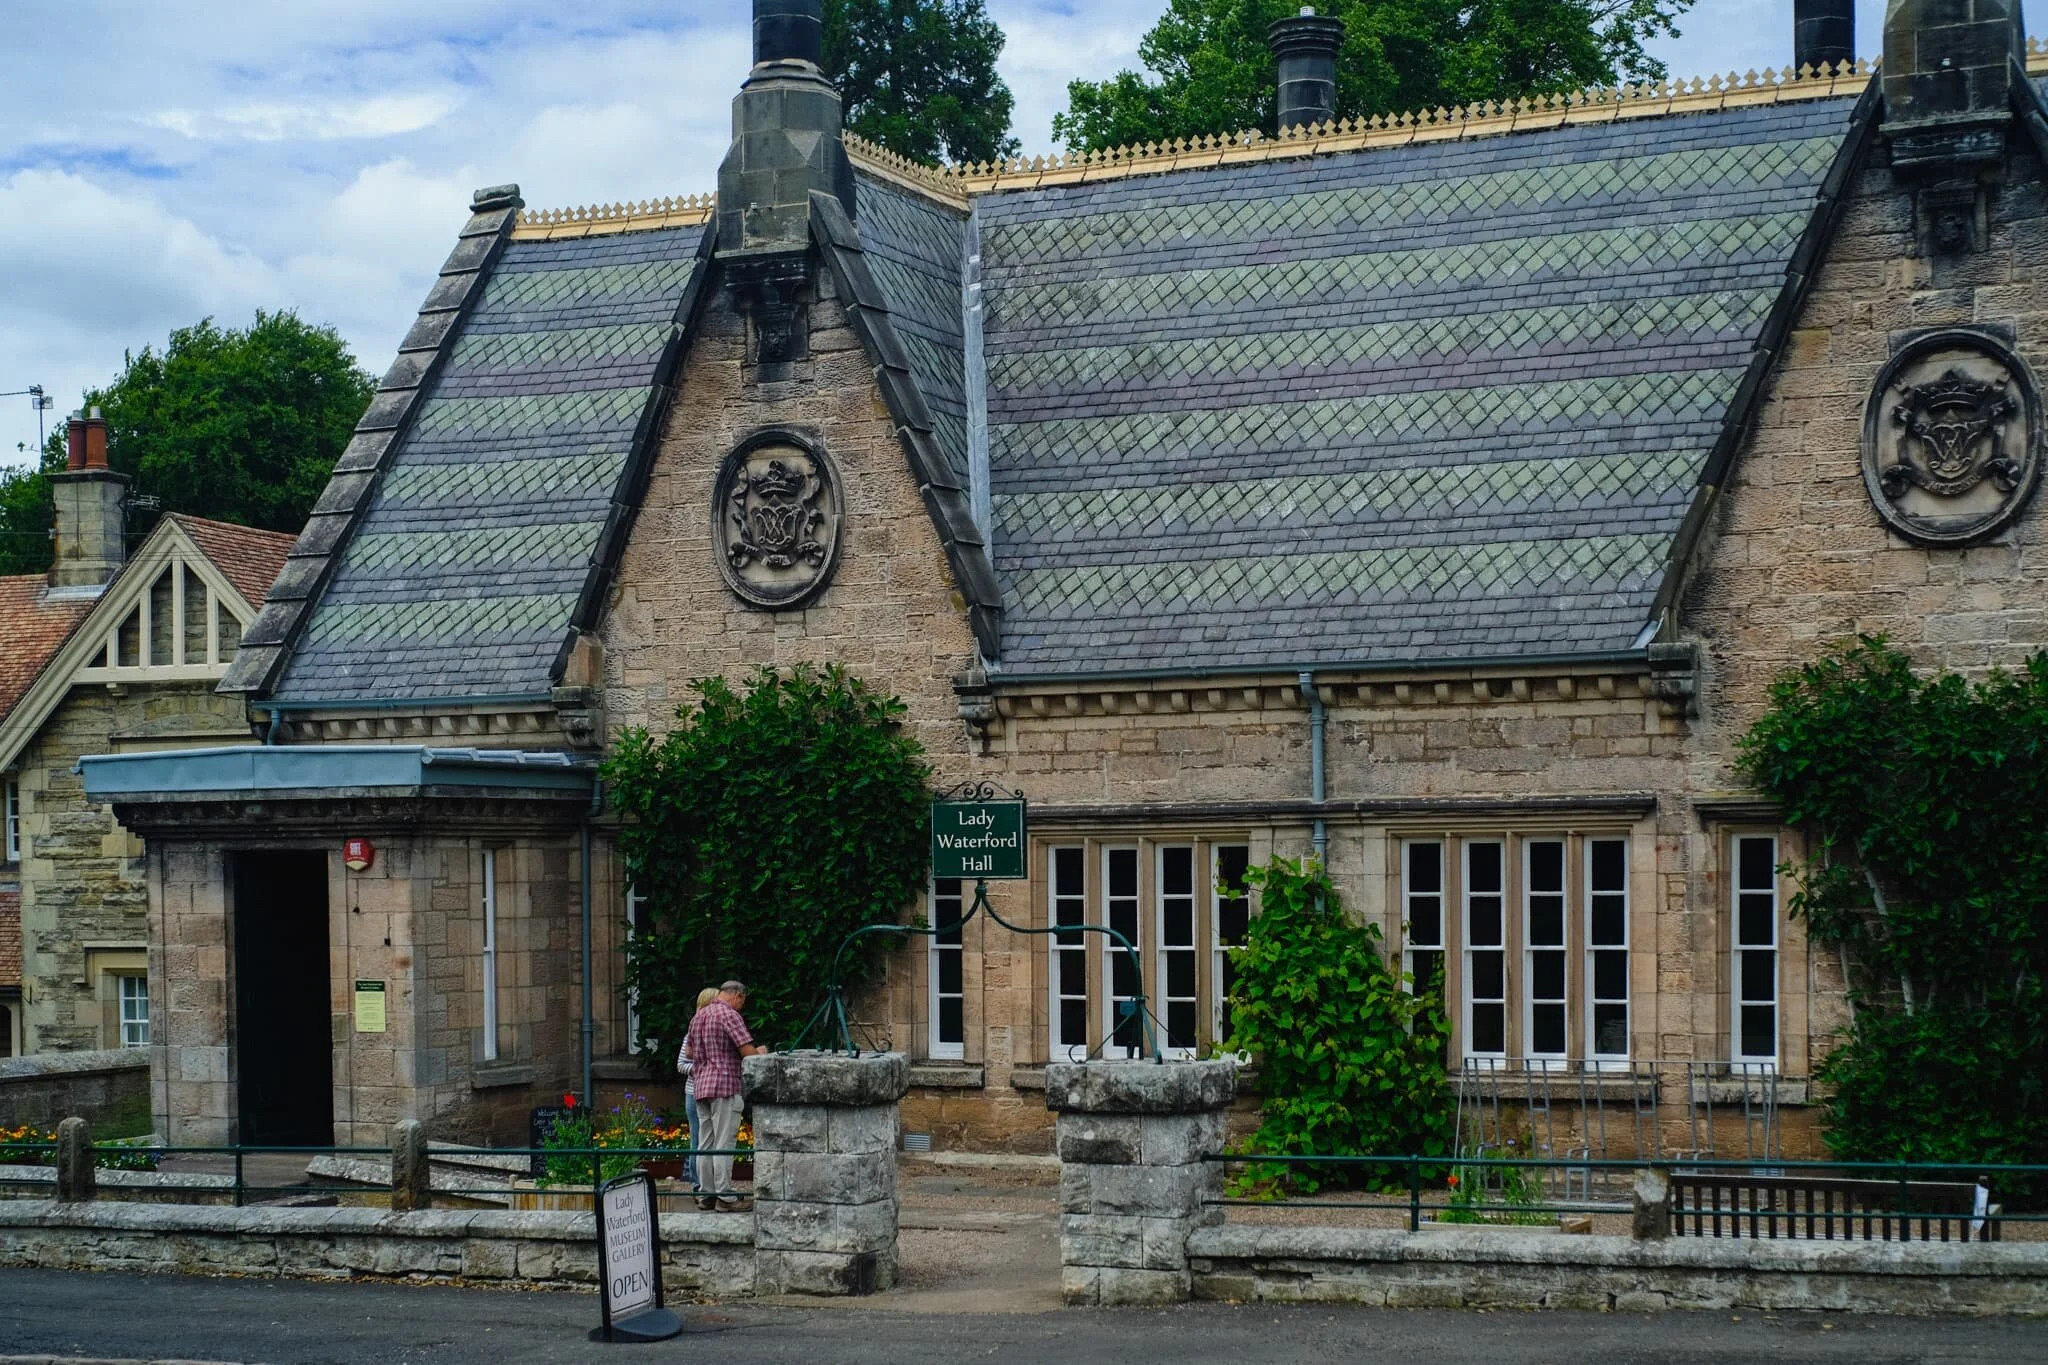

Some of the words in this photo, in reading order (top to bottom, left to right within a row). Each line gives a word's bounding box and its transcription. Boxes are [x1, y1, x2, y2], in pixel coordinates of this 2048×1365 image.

[958, 809, 995, 830] Lady
[936, 831, 1017, 849] Waterford
[961, 855, 993, 871] Hall
[615, 1192, 634, 1210] Lady
[606, 1207, 646, 1231] Waterford
[610, 1226, 646, 1249] MUSEUM
[612, 1241, 646, 1263] GALLERY
[612, 1269, 649, 1299] OPEN
